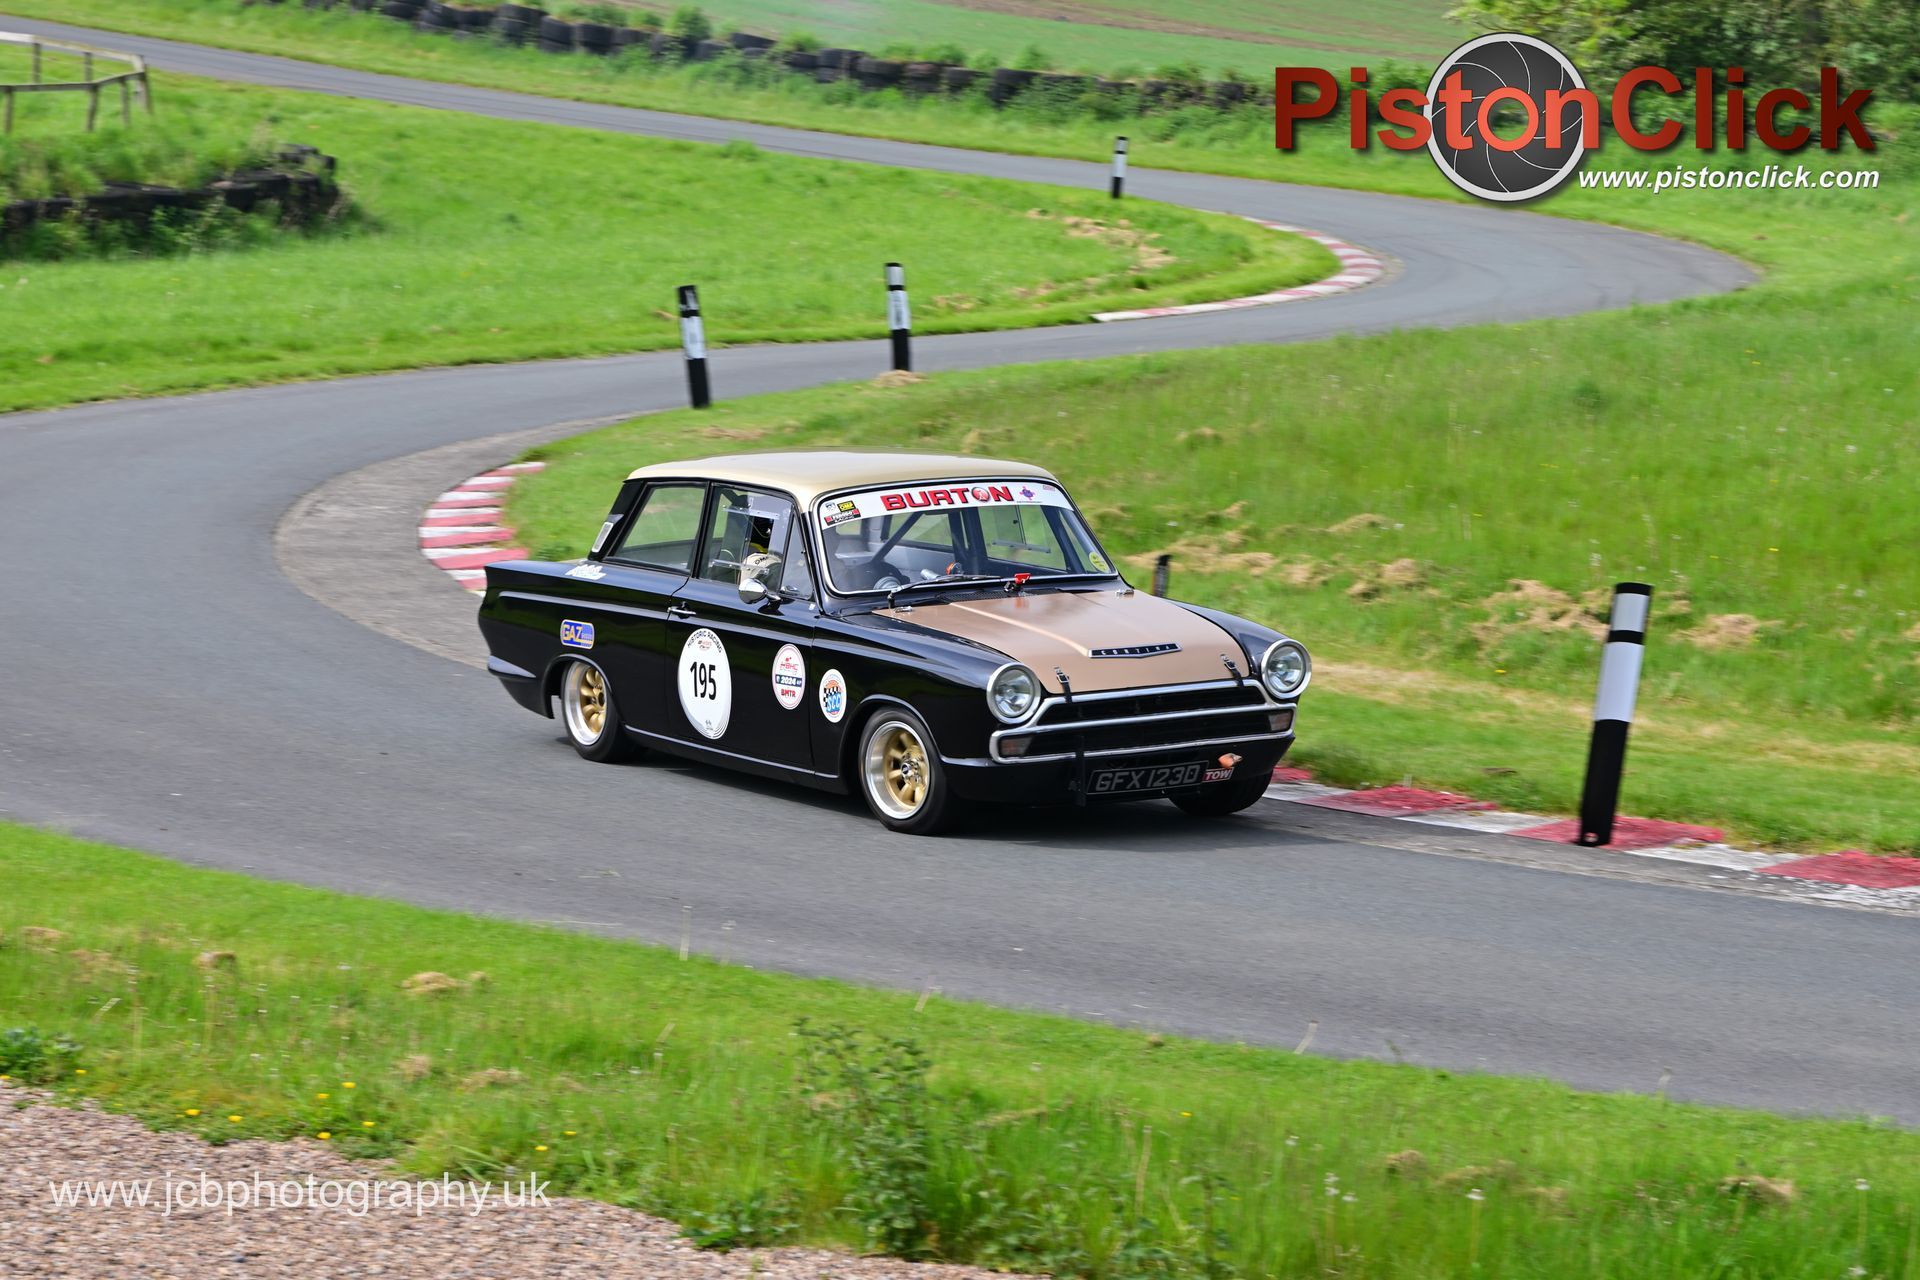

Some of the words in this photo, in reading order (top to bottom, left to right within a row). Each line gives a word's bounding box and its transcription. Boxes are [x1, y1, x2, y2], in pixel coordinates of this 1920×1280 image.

[881, 486, 1014, 511] BURTON
[561, 624, 583, 642] GAZ
[1101, 645, 1170, 656] CORTINA
[689, 661, 717, 701] 195
[780, 675, 797, 686] 2024
[1095, 769, 1145, 792] GFX
[1205, 770, 1231, 781] TOW
